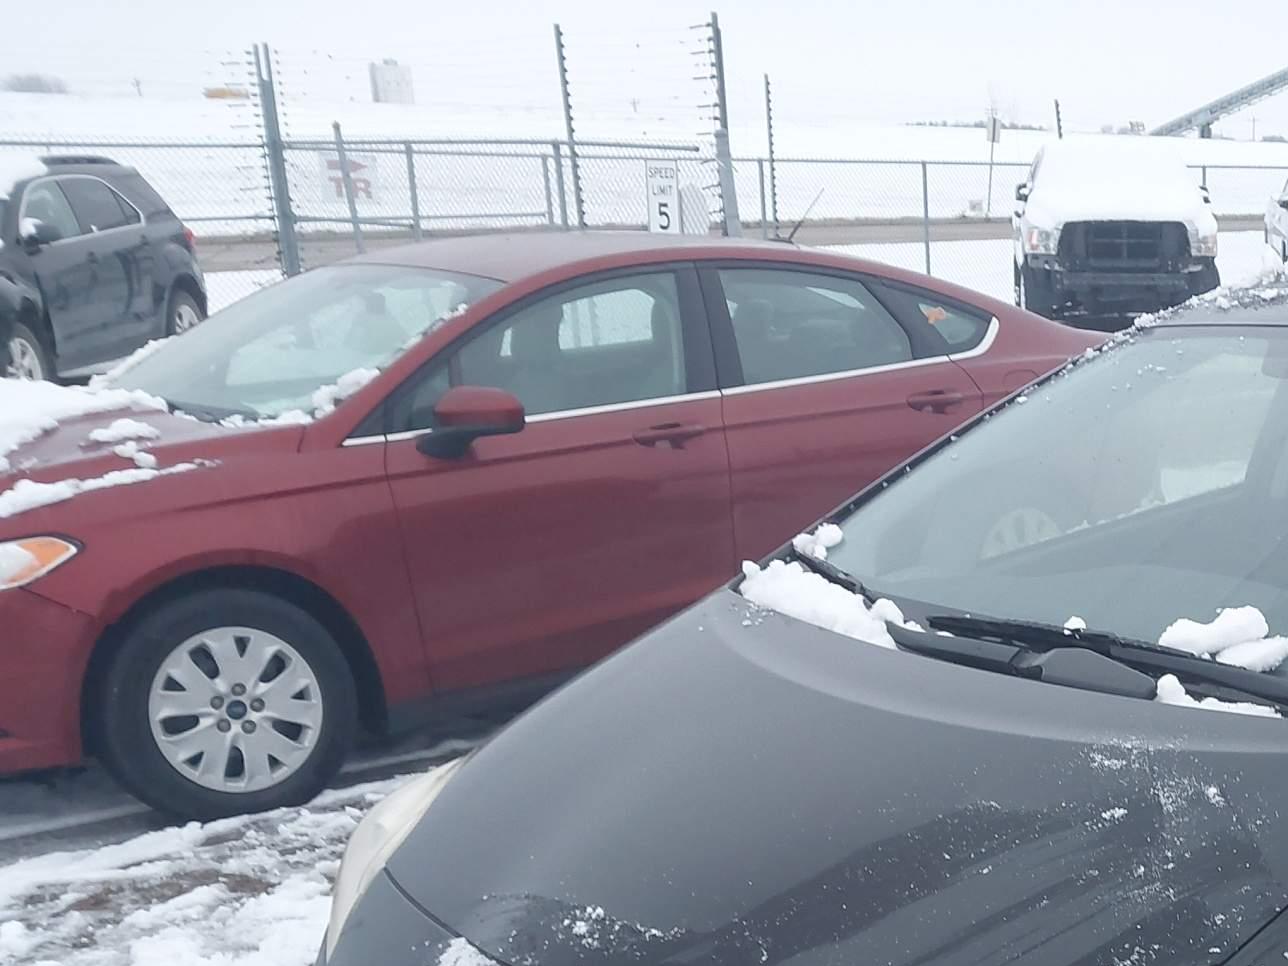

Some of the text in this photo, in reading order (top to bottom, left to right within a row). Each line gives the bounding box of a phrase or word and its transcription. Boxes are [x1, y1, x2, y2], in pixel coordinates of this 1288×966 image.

[648, 166, 675, 179] SPEED
[651, 184, 673, 196] LIMIT
[657, 202, 671, 230] 5
